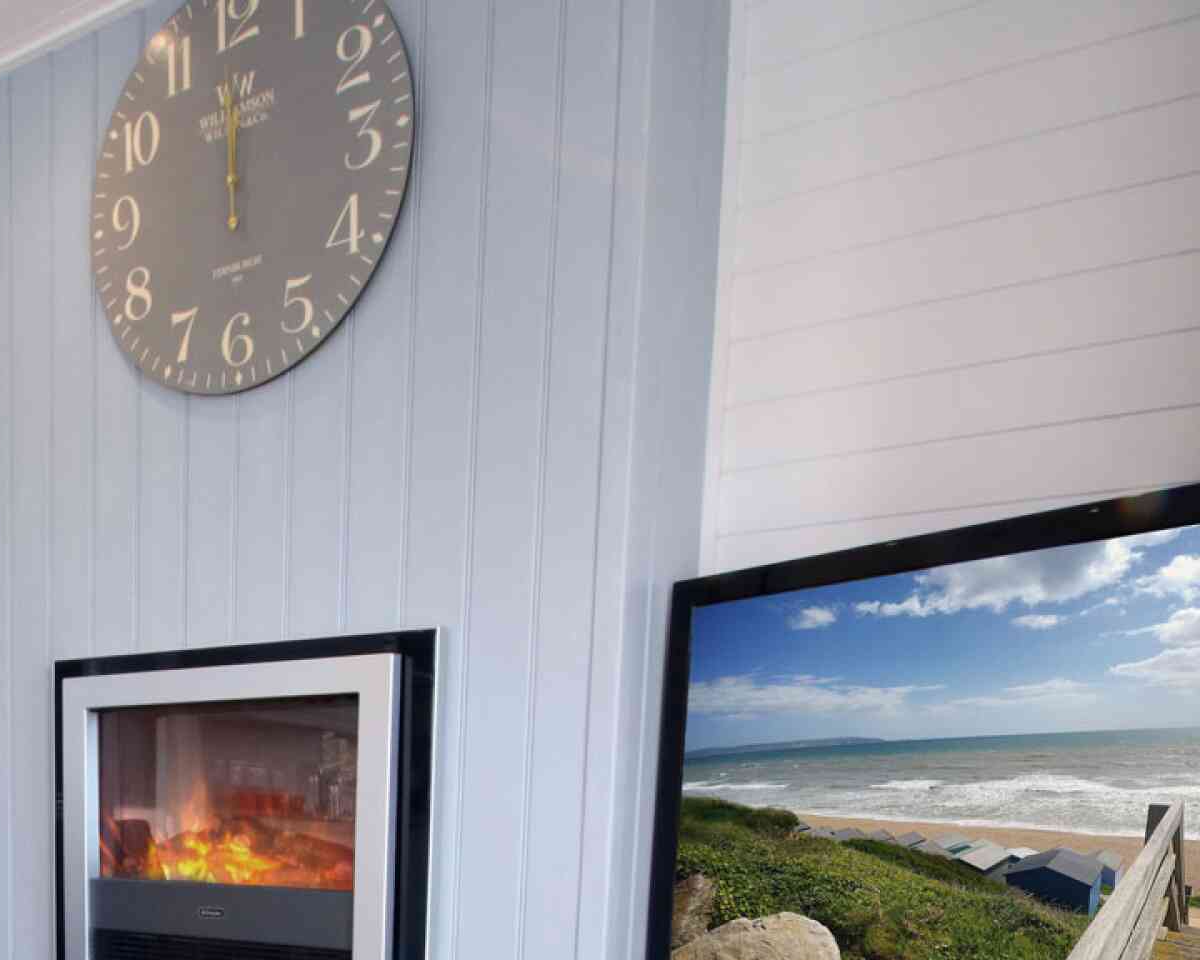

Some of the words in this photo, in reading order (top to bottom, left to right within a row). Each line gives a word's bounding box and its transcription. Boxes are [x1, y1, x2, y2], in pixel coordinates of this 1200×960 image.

[216, 0, 260, 54] 12
[165, 36, 192, 97] 11
[336, 24, 373, 94] 2
[122, 111, 161, 174] 10
[344, 99, 382, 170] 3
[112, 194, 141, 251] 9
[325, 192, 365, 255] 4
[124, 266, 153, 321] 8
[280, 273, 314, 334] 5
[171, 305, 199, 364] 7
[221, 312, 254, 367] 6
